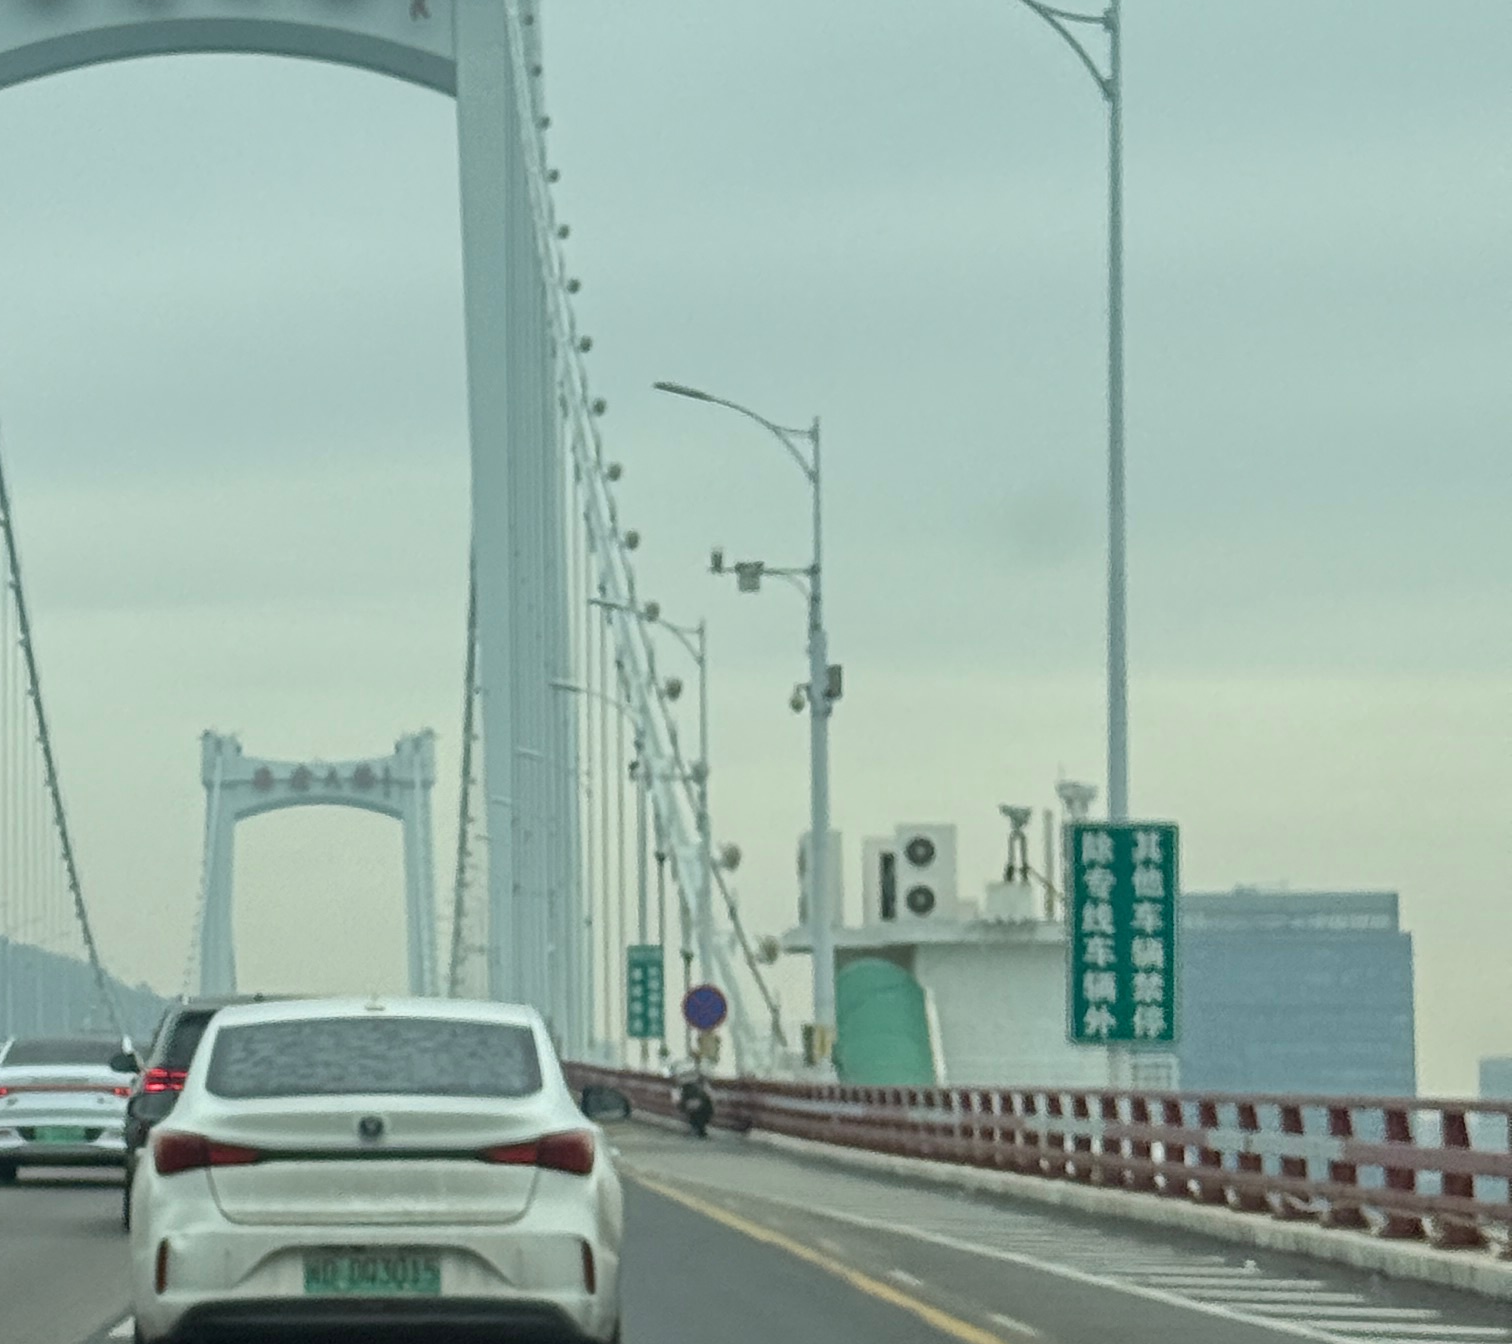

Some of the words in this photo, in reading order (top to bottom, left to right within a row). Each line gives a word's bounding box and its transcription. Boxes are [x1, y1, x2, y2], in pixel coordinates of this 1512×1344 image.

[1081, 829, 1117, 1038] 除专线车辆外
[1131, 829, 1167, 1039] 其他车辆禁停
